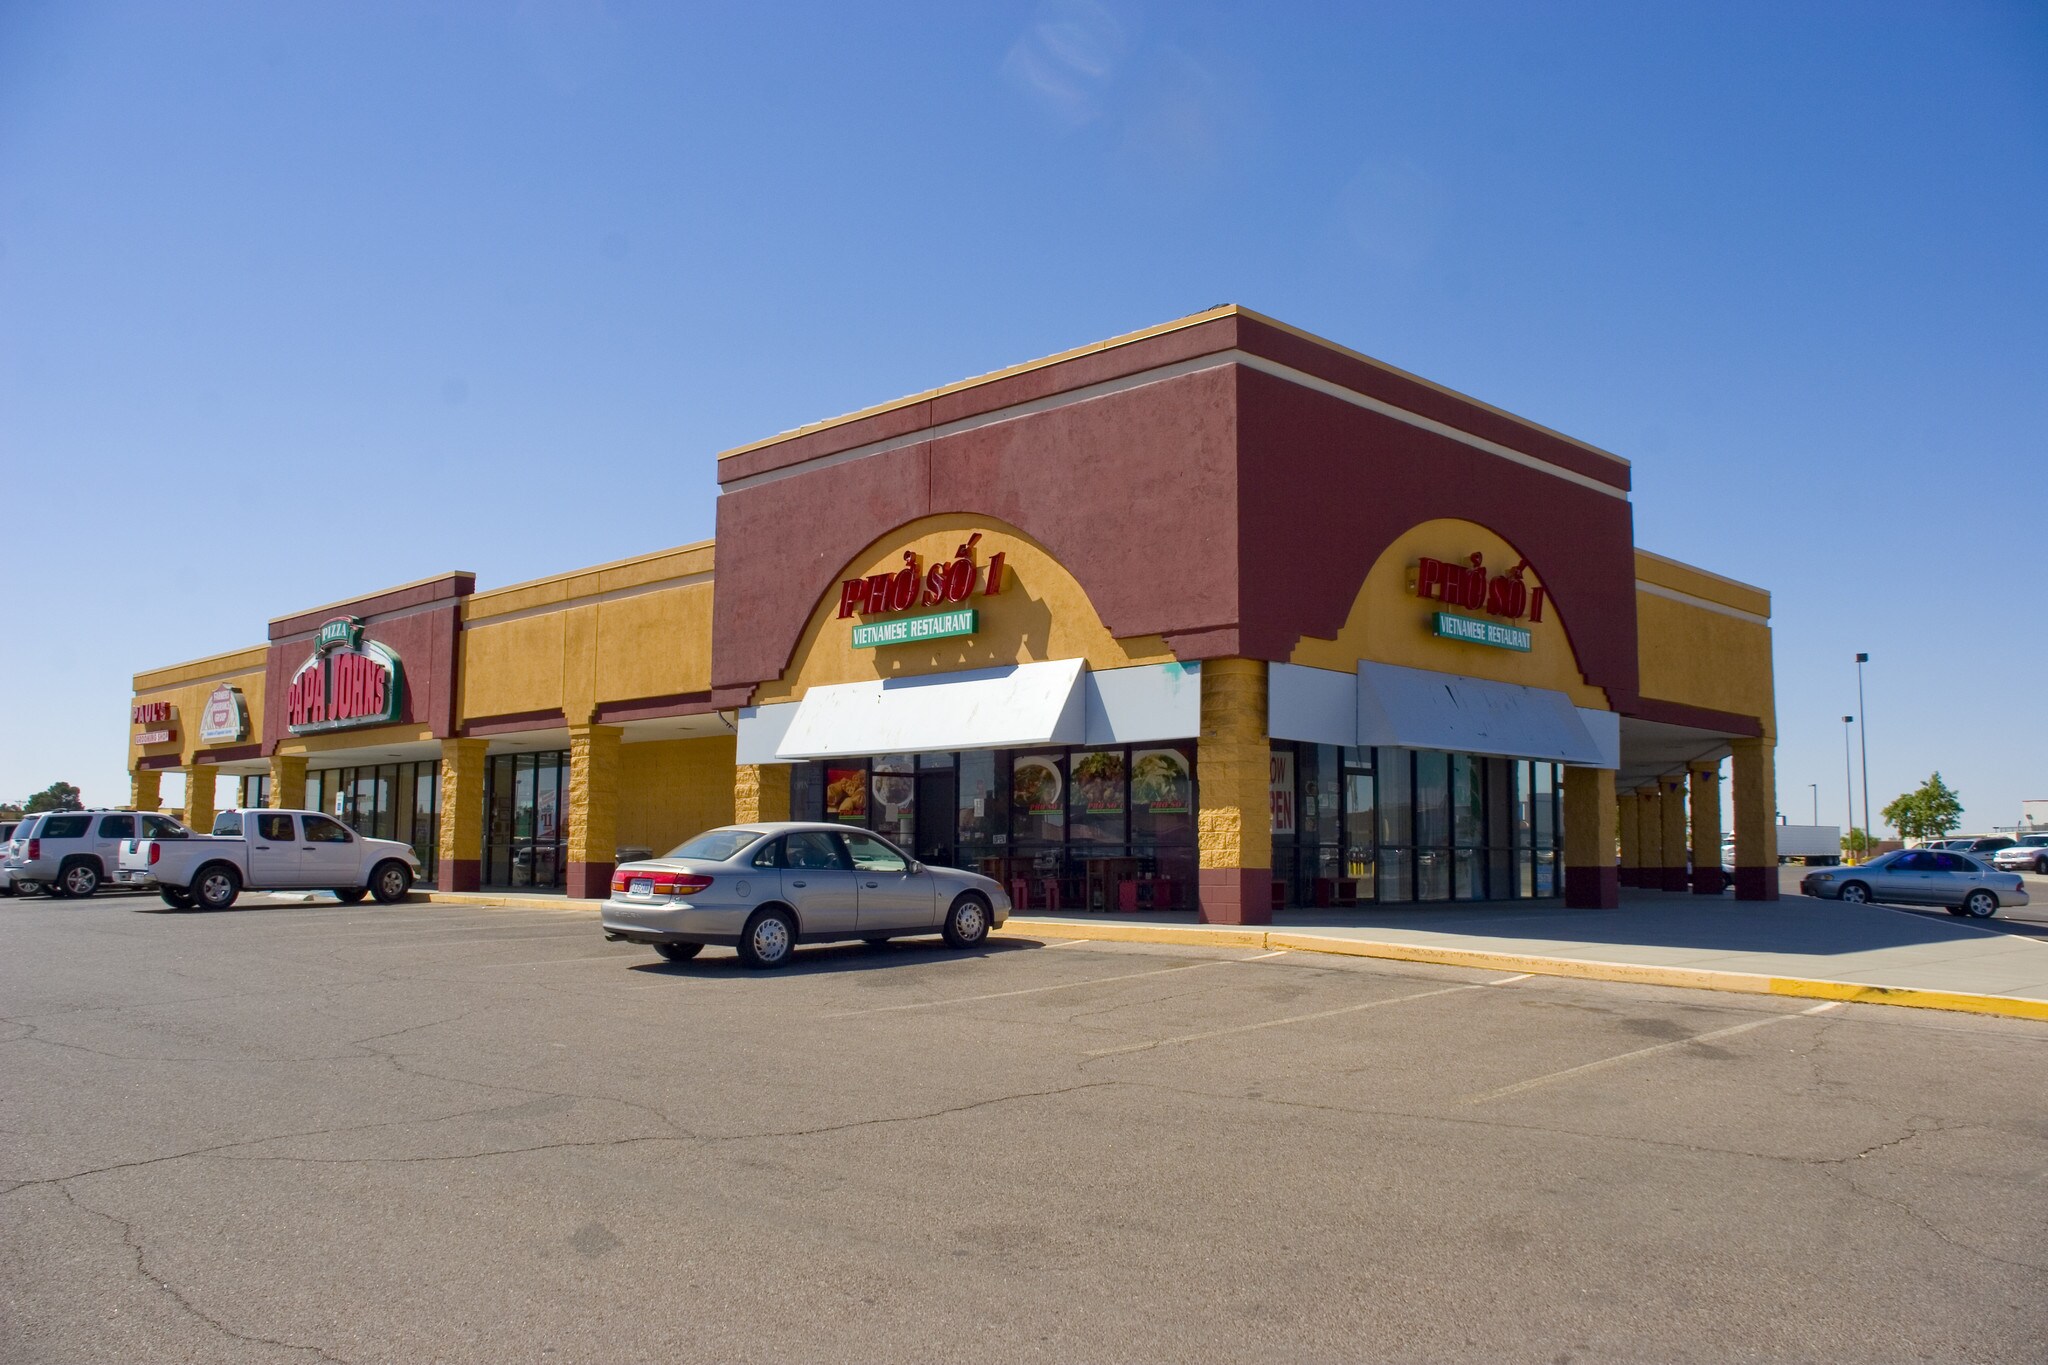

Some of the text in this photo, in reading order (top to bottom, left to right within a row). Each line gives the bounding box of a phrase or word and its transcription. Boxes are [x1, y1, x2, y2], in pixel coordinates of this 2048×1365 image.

[982, 552, 1006, 596] 1
[322, 623, 347, 641] PIZZA
[853, 612, 972, 645] VIETNAMESE RESTAURANT
[1440, 615, 1531, 649] VIETNAMESE RESTAURANT
[287, 660, 326, 726] PAPA
[158, 730, 169, 741] SHOP
[1270, 757, 1286, 784] OW
[1270, 791, 1292, 829] PEN
